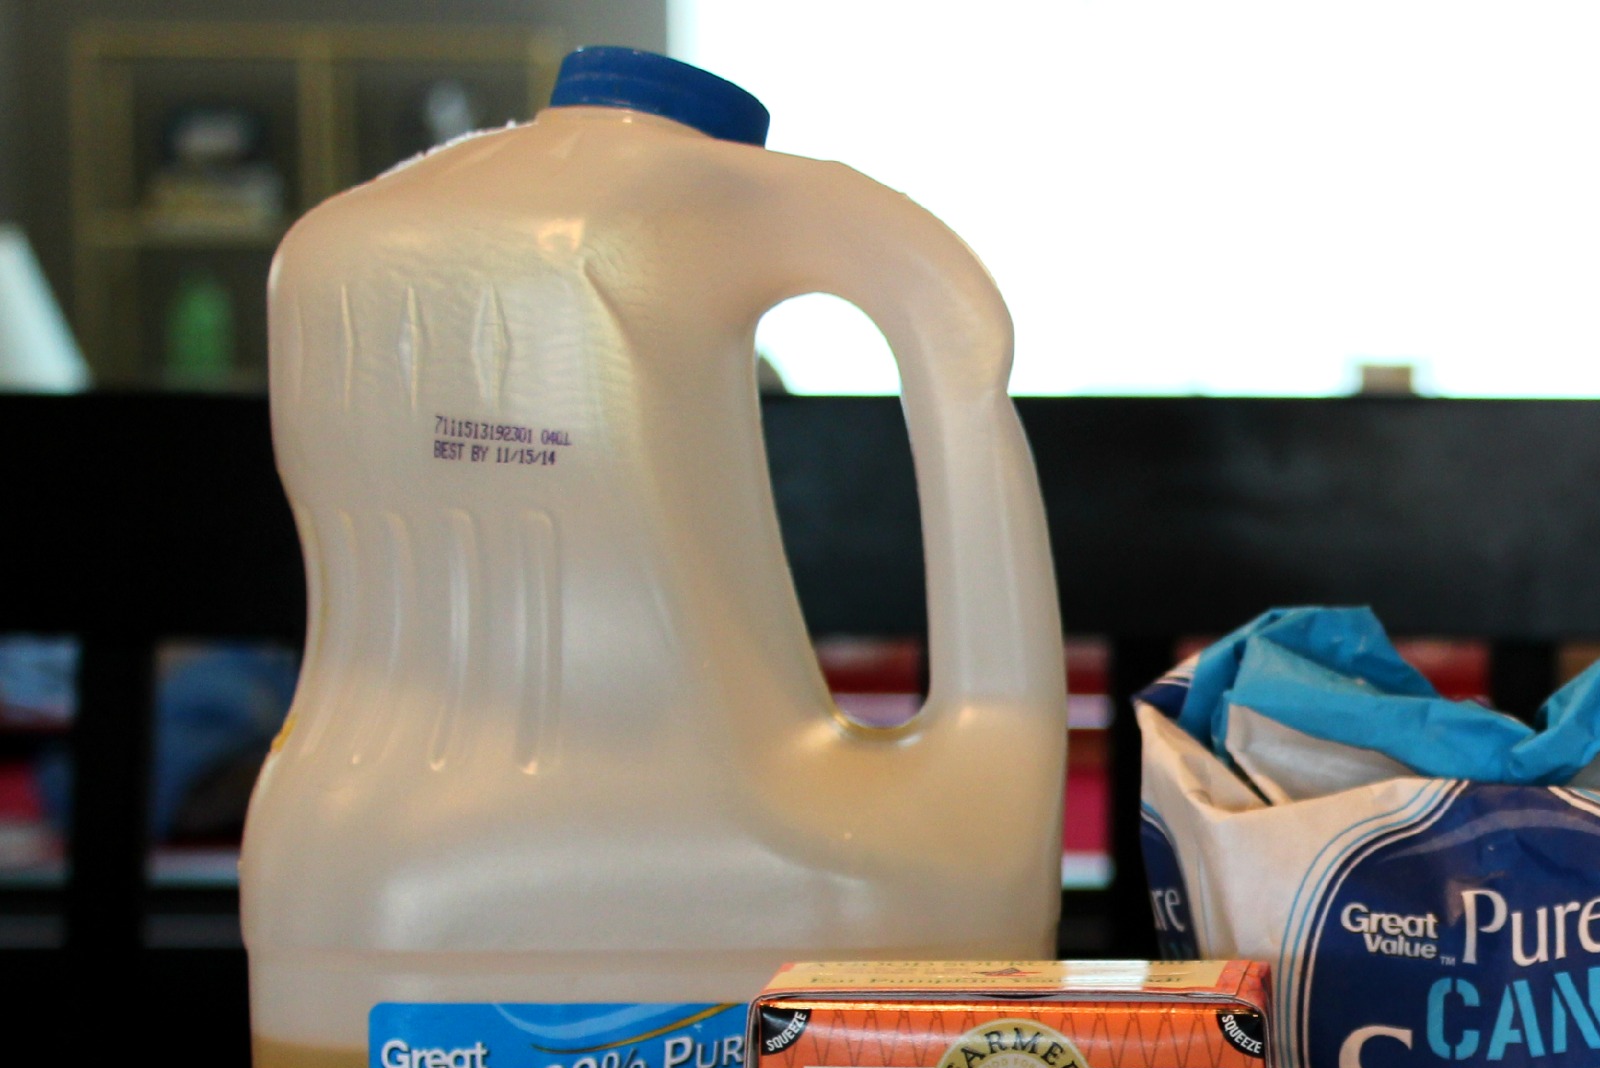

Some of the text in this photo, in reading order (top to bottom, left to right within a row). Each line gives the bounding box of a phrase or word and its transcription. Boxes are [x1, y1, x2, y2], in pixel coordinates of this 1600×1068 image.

[434, 440, 556, 466] BEST BY 11/15/14
[1340, 902, 1438, 940] Great
[1363, 932, 1437, 960] Value
[766, 1011, 807, 1052] SQUEEZE
[1221, 1014, 1263, 1054] SQUEEZE
